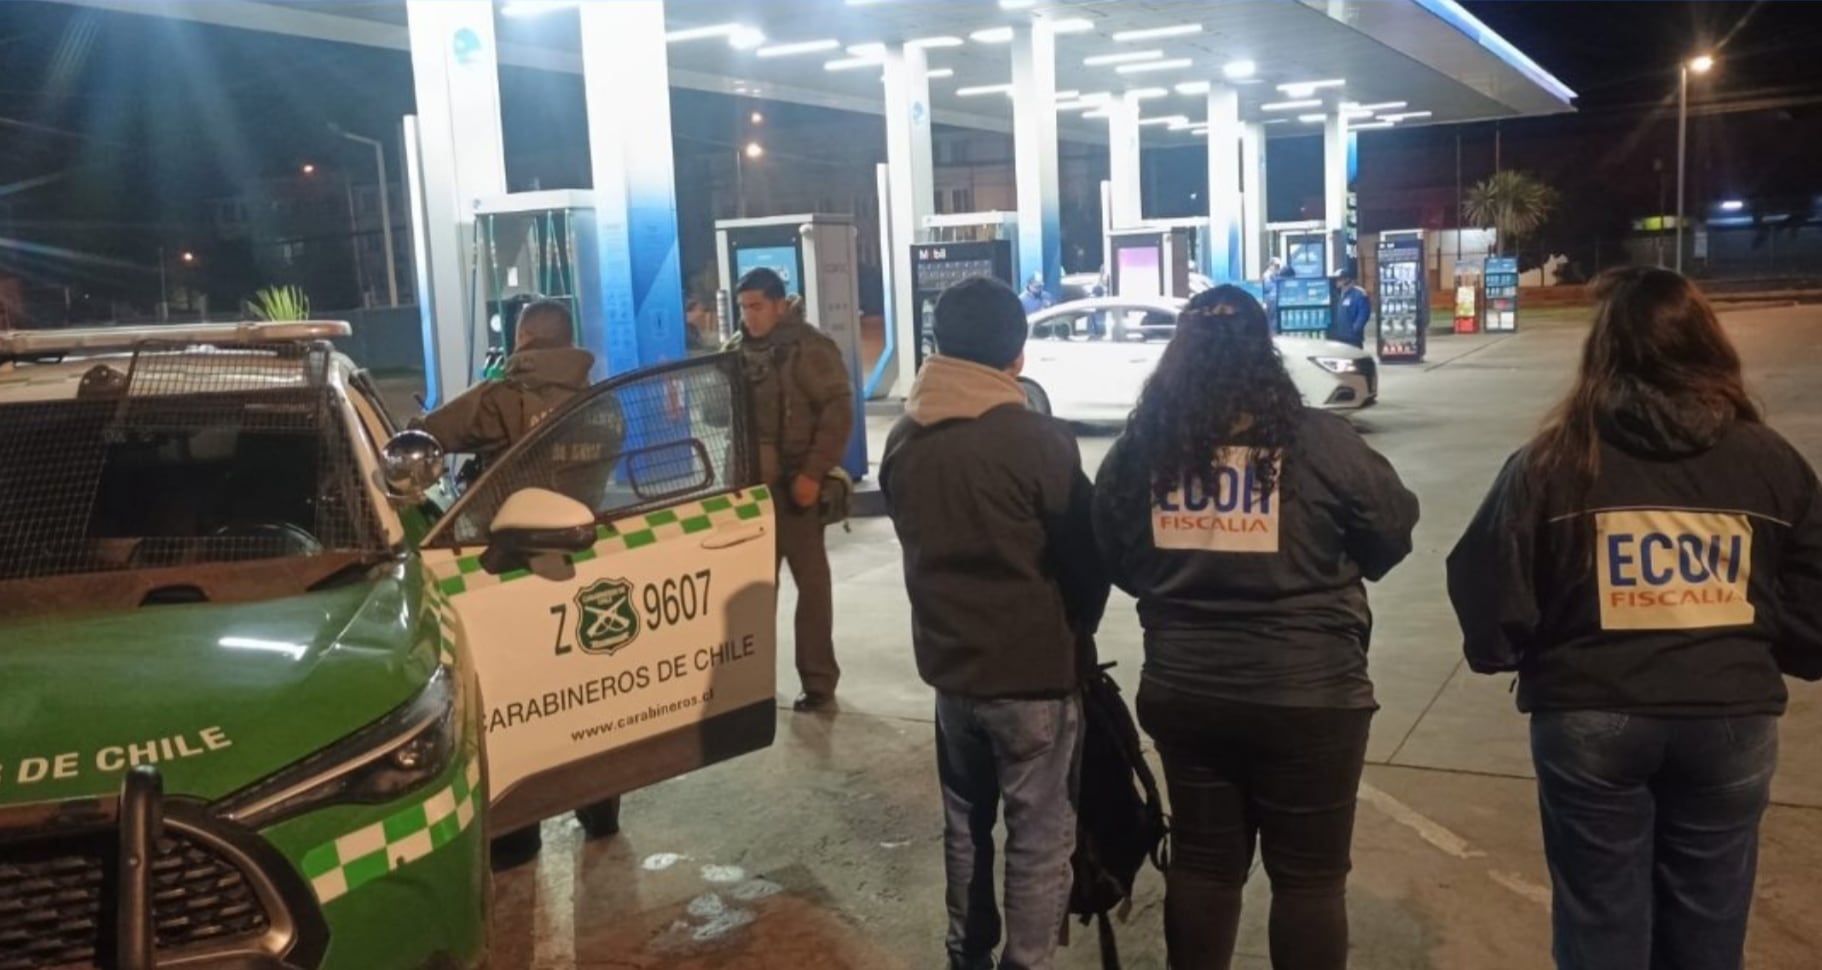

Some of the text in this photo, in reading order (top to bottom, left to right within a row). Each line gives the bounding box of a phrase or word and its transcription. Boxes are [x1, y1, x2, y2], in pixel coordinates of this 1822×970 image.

[1159, 516, 1269, 533] FISCALIA
[550, 569, 712, 656] Z 9607
[657, 654, 687, 682] DE
[693, 634, 756, 671] CHILE
[571, 688, 714, 741] www.carabineros.cl
[17, 752, 79, 784] DE
[95, 726, 232, 771] CHILE
